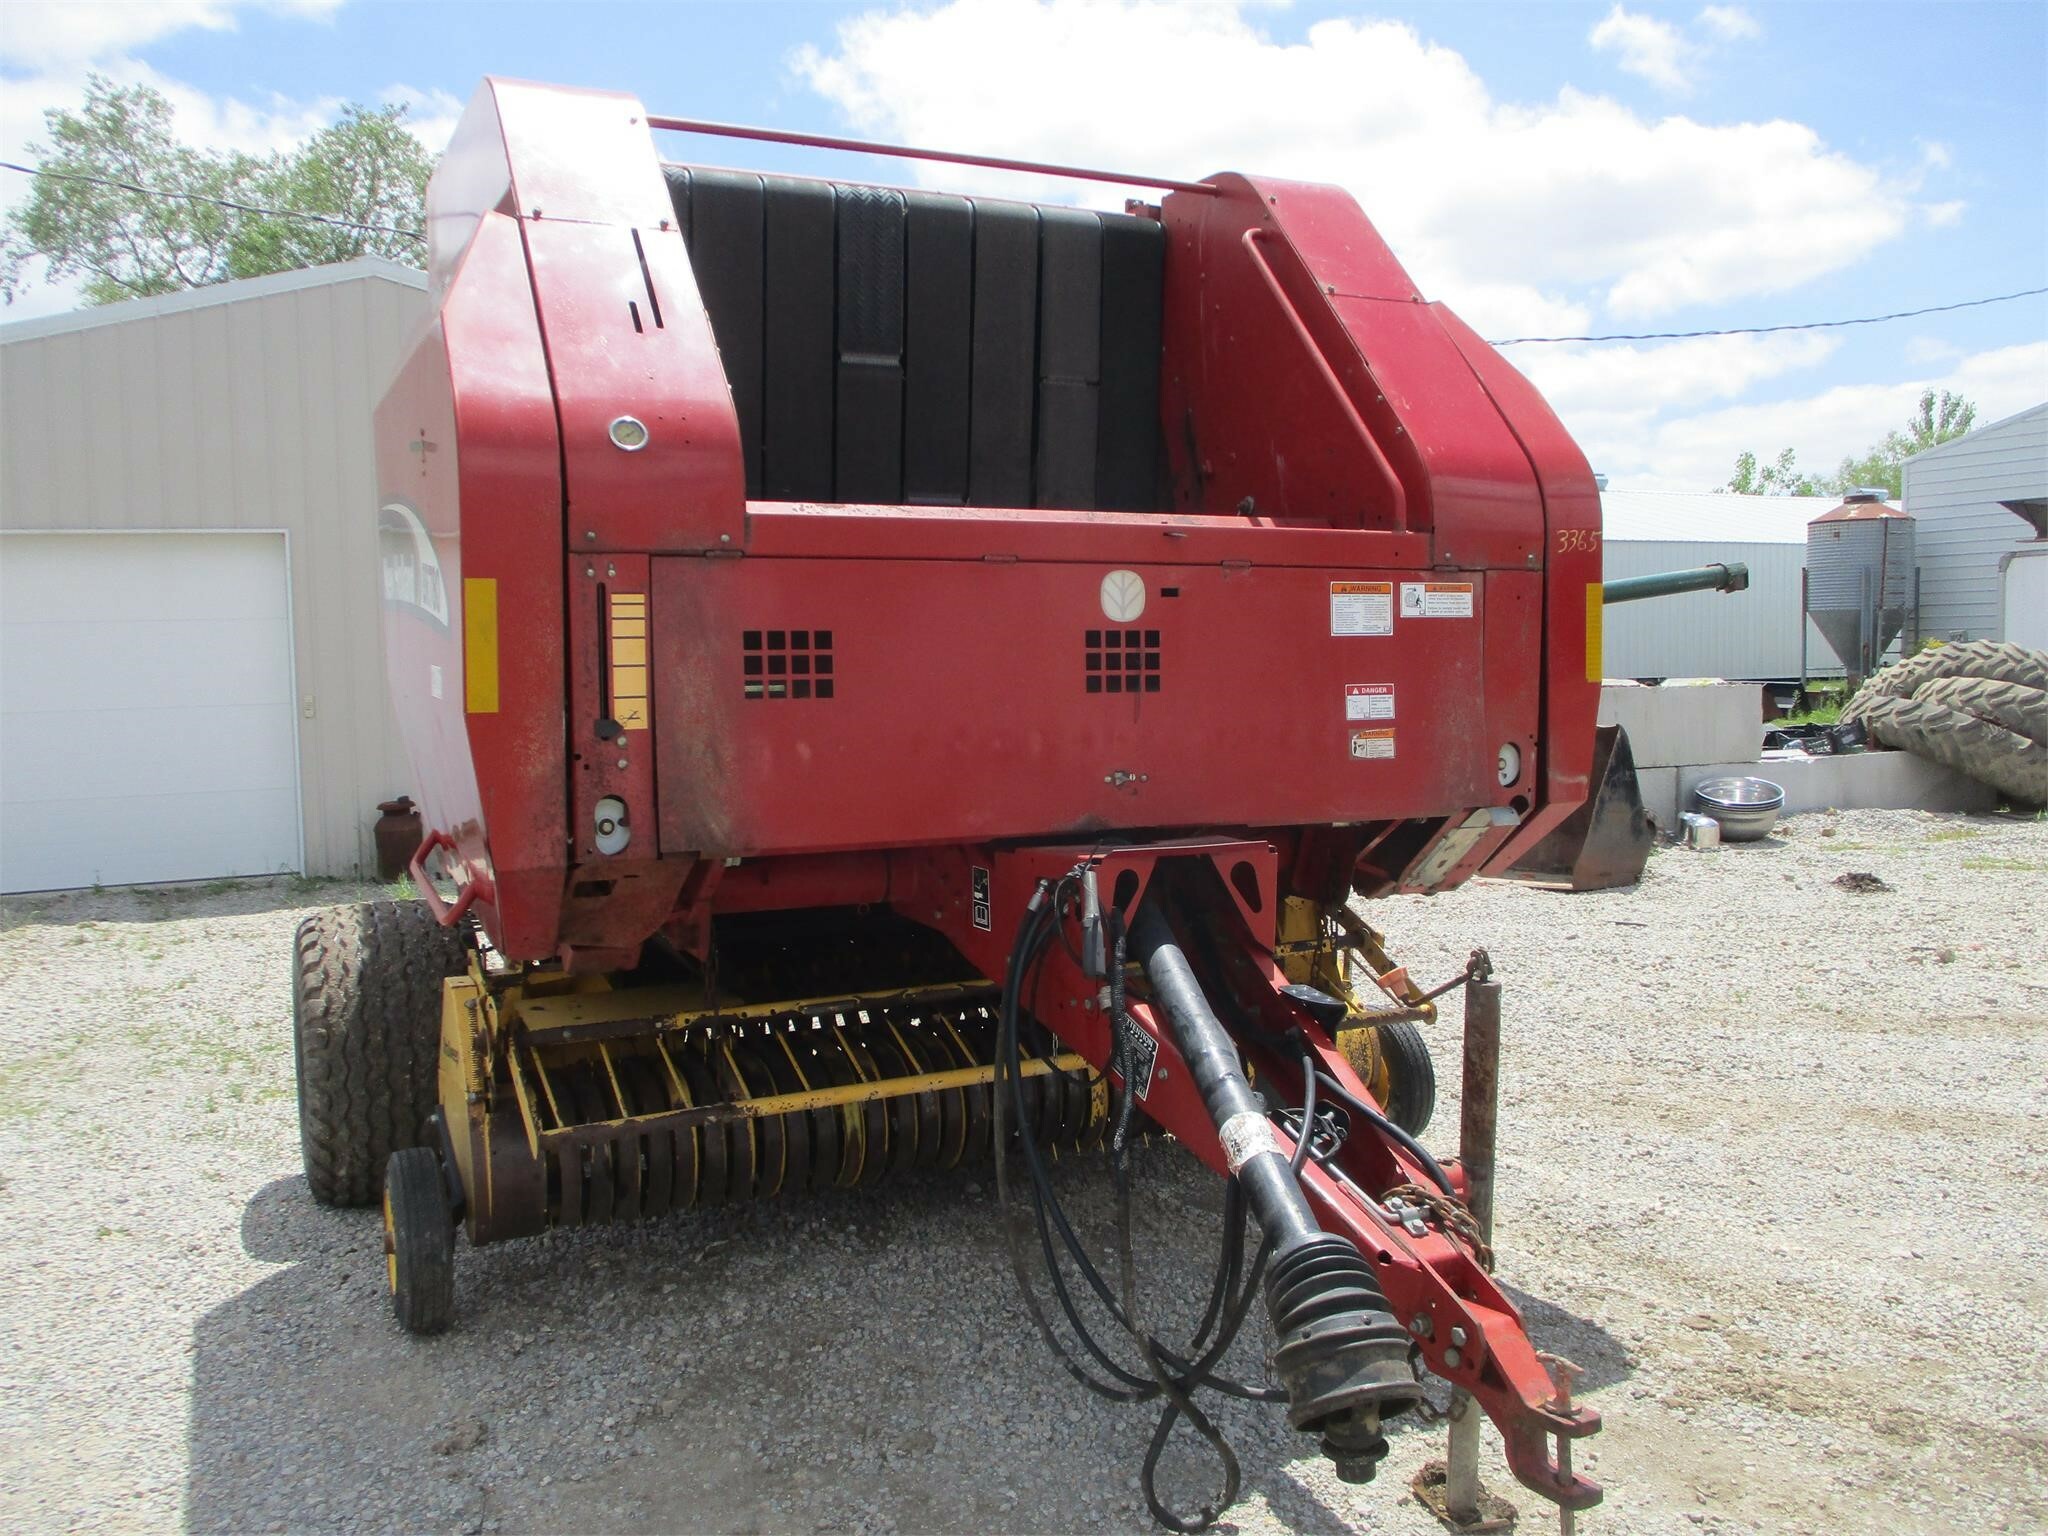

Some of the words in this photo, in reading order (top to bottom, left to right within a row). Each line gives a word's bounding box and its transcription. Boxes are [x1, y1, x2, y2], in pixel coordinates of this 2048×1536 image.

[1557, 529, 1602, 553] 3365
[1350, 584, 1382, 592] WARNING
[1125, 1017, 1154, 1048] TTENTION
